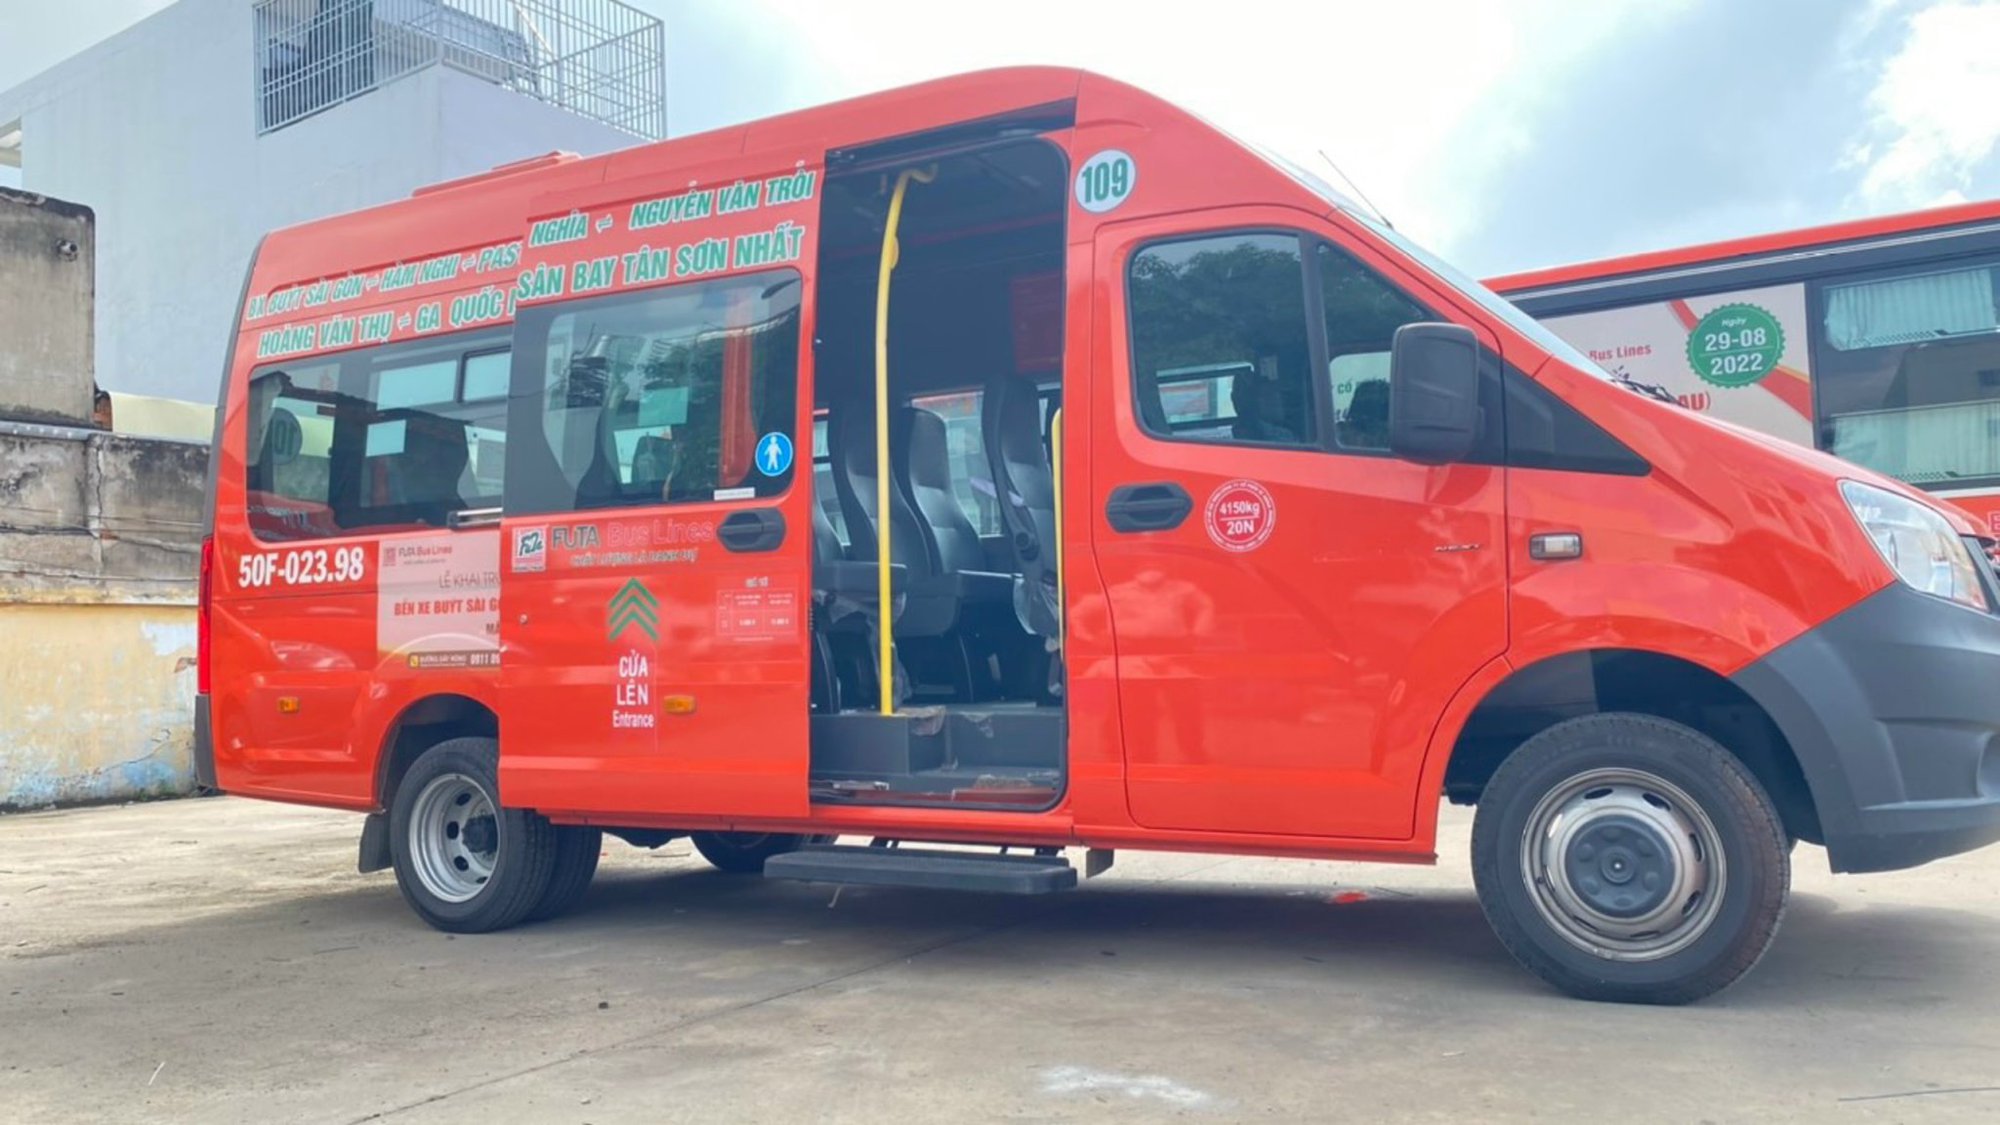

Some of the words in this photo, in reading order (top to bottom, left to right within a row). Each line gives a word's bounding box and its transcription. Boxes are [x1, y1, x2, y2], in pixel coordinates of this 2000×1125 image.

[1082, 158, 1127, 203] 109
[476, 241, 522, 273] PAS
[517, 261, 565, 301] SÂN
[571, 256, 618, 293] BAY
[622, 244, 670, 285] TÂN
[675, 238, 729, 277] SƠN
[733, 220, 805, 268] NHẤT
[415, 302, 441, 332] GA
[449, 286, 505, 327] QUỐC
[1616, 345, 1652, 358] Lines
[1705, 328, 1766, 351] 29-08
[1711, 353, 1763, 376] 2022
[1220, 501, 1260, 516] 4150kg
[552, 525, 600, 549] FUTA
[607, 522, 650, 547] Bus
[652, 518, 714, 545] Lines
[1227, 520, 1254, 535] 20N
[238, 546, 364, 588] 50F-023.98
[619, 649, 648, 677] CỬA
[617, 678, 648, 705] LÊN
[613, 710, 654, 728] Entrance
